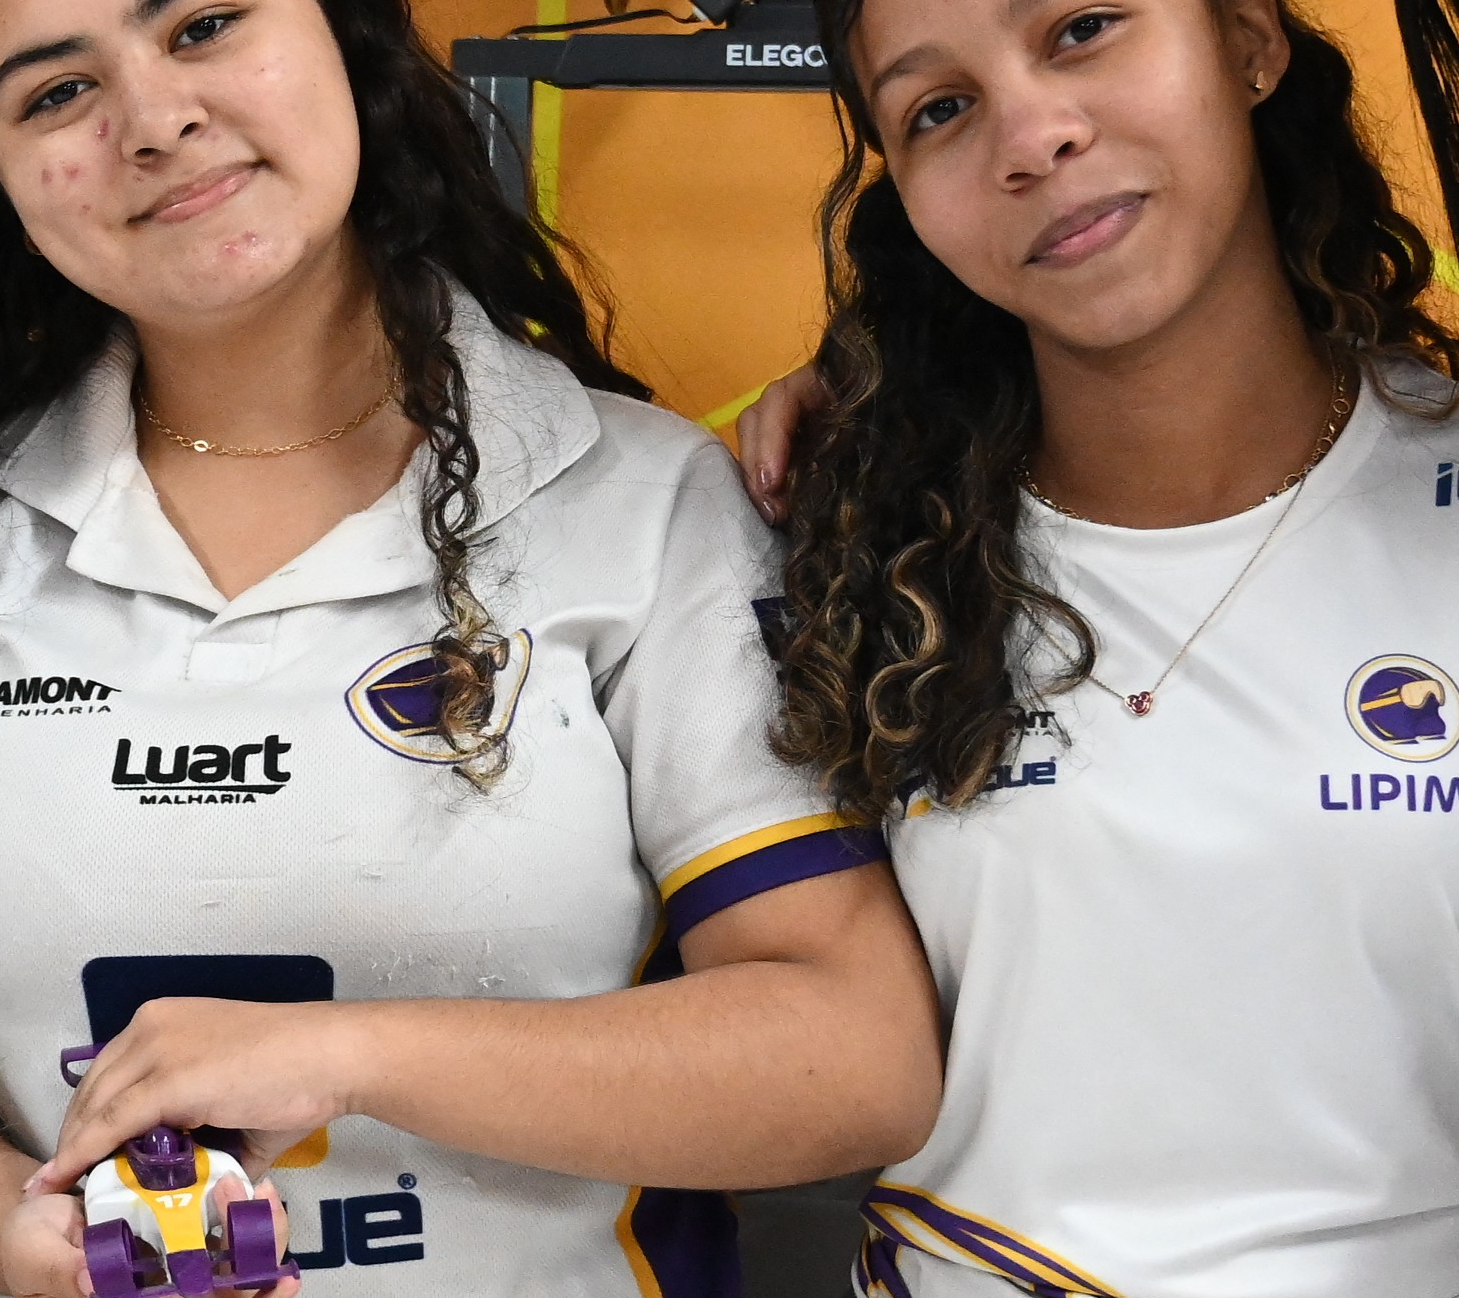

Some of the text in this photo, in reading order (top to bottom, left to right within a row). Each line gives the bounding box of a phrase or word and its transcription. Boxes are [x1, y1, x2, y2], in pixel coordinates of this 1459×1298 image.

[726, 44, 828, 67] ELEGO
[112, 735, 292, 784] Luart
[139, 793, 256, 805] MALHARIA
[155, 1192, 193, 1209] 17
